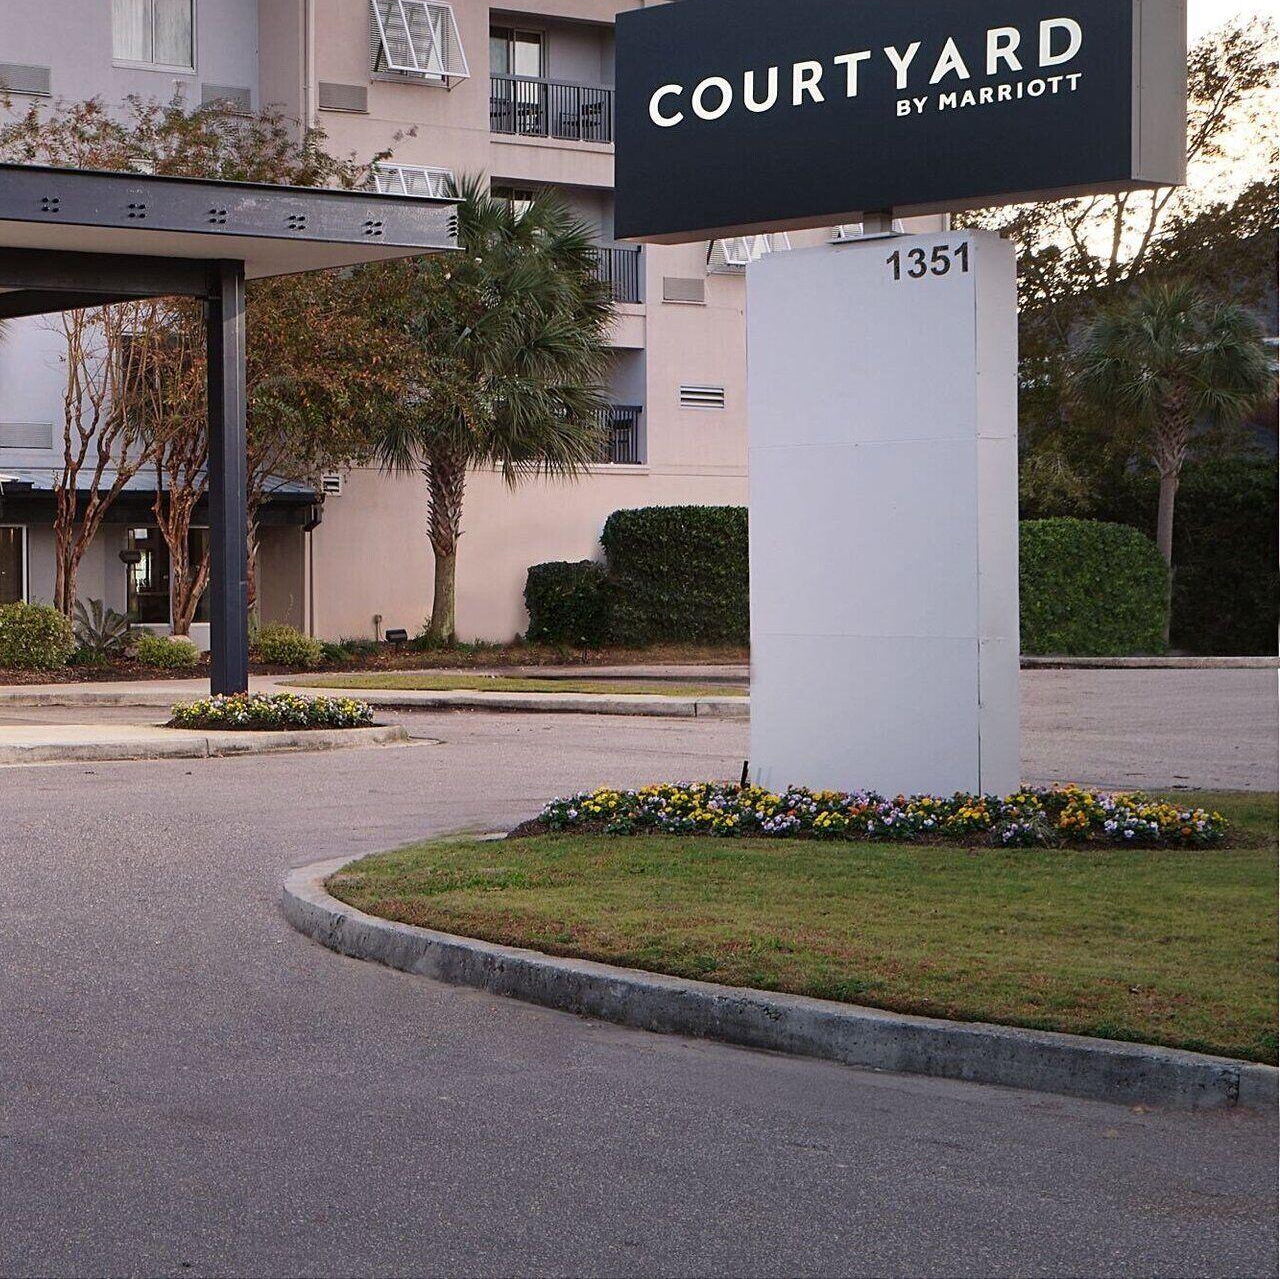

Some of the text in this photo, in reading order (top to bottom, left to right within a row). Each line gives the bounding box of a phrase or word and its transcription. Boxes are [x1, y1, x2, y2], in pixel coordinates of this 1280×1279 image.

[648, 17, 1083, 127] COURTYARD
[896, 72, 1082, 117] BY MARRIOTT
[885, 241, 969, 281] 1351
